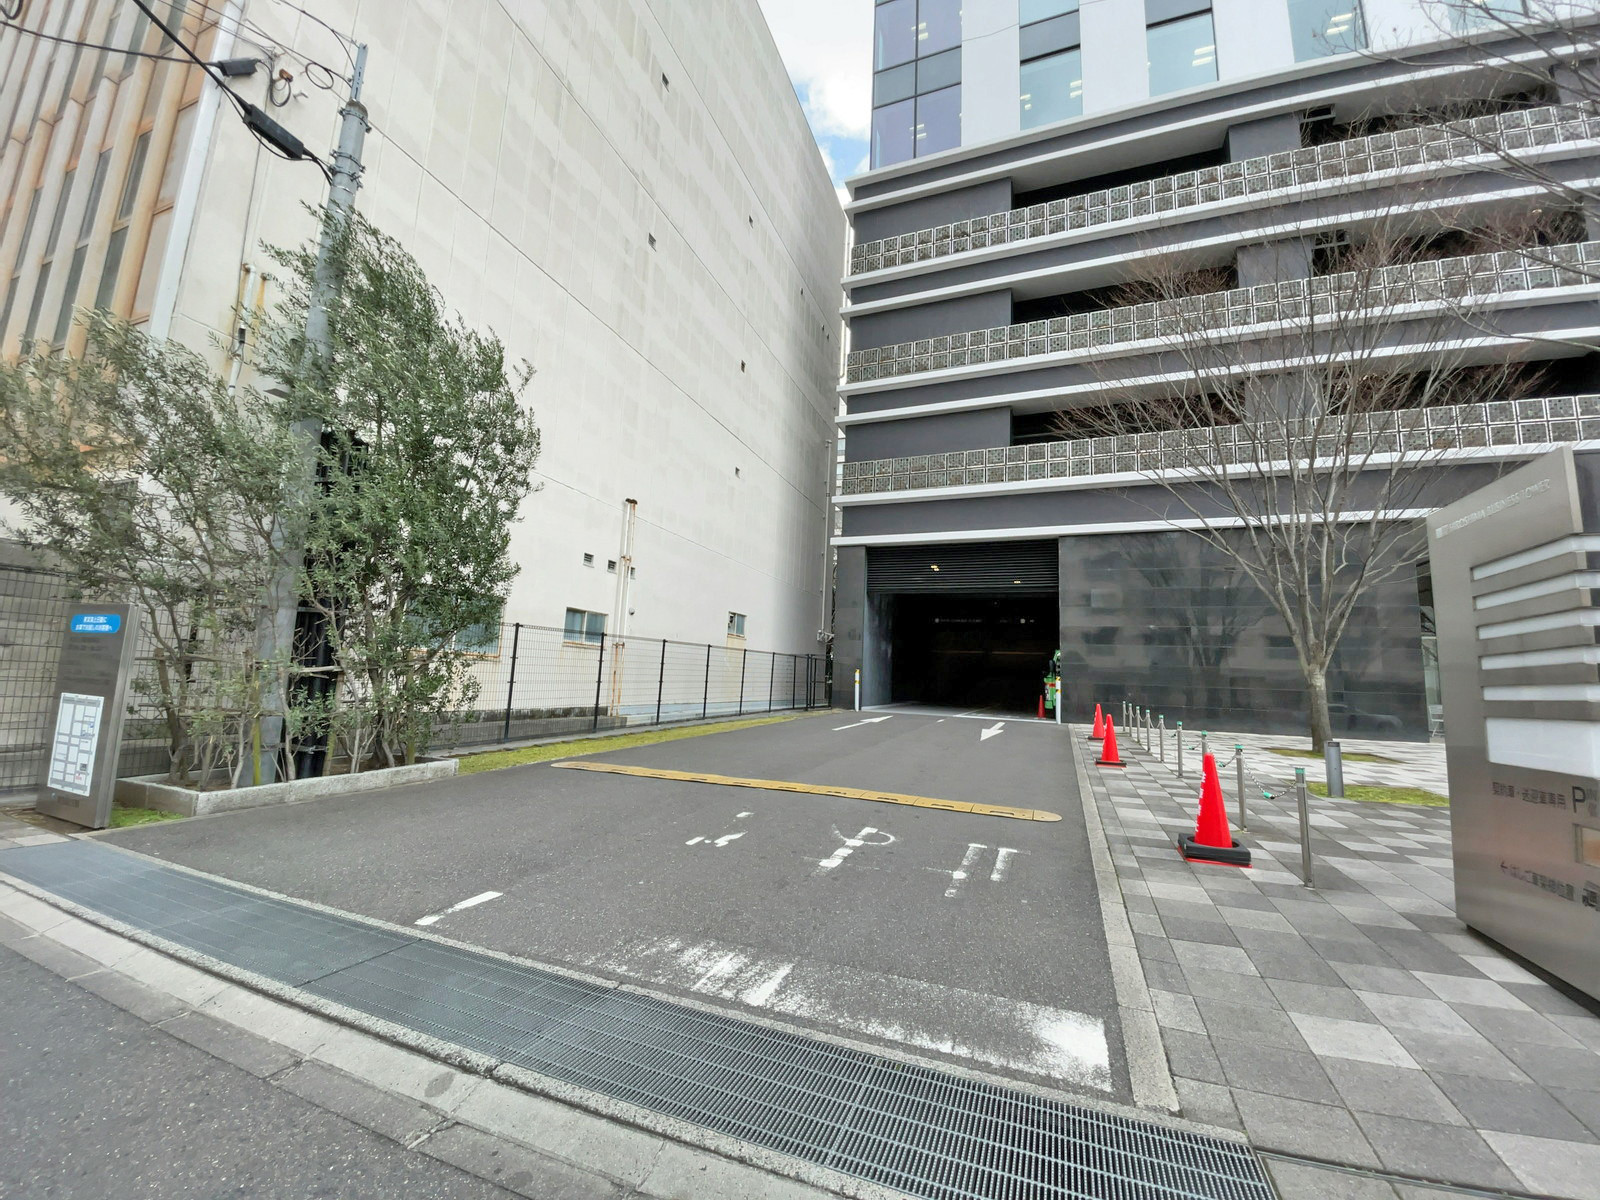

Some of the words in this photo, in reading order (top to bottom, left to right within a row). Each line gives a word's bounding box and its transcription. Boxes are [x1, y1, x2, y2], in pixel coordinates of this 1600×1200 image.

[1449, 510, 1486, 531] HIROSHIMA
[1486, 493, 1520, 517] BUSINESS
[1572, 785, 1586, 814] P
